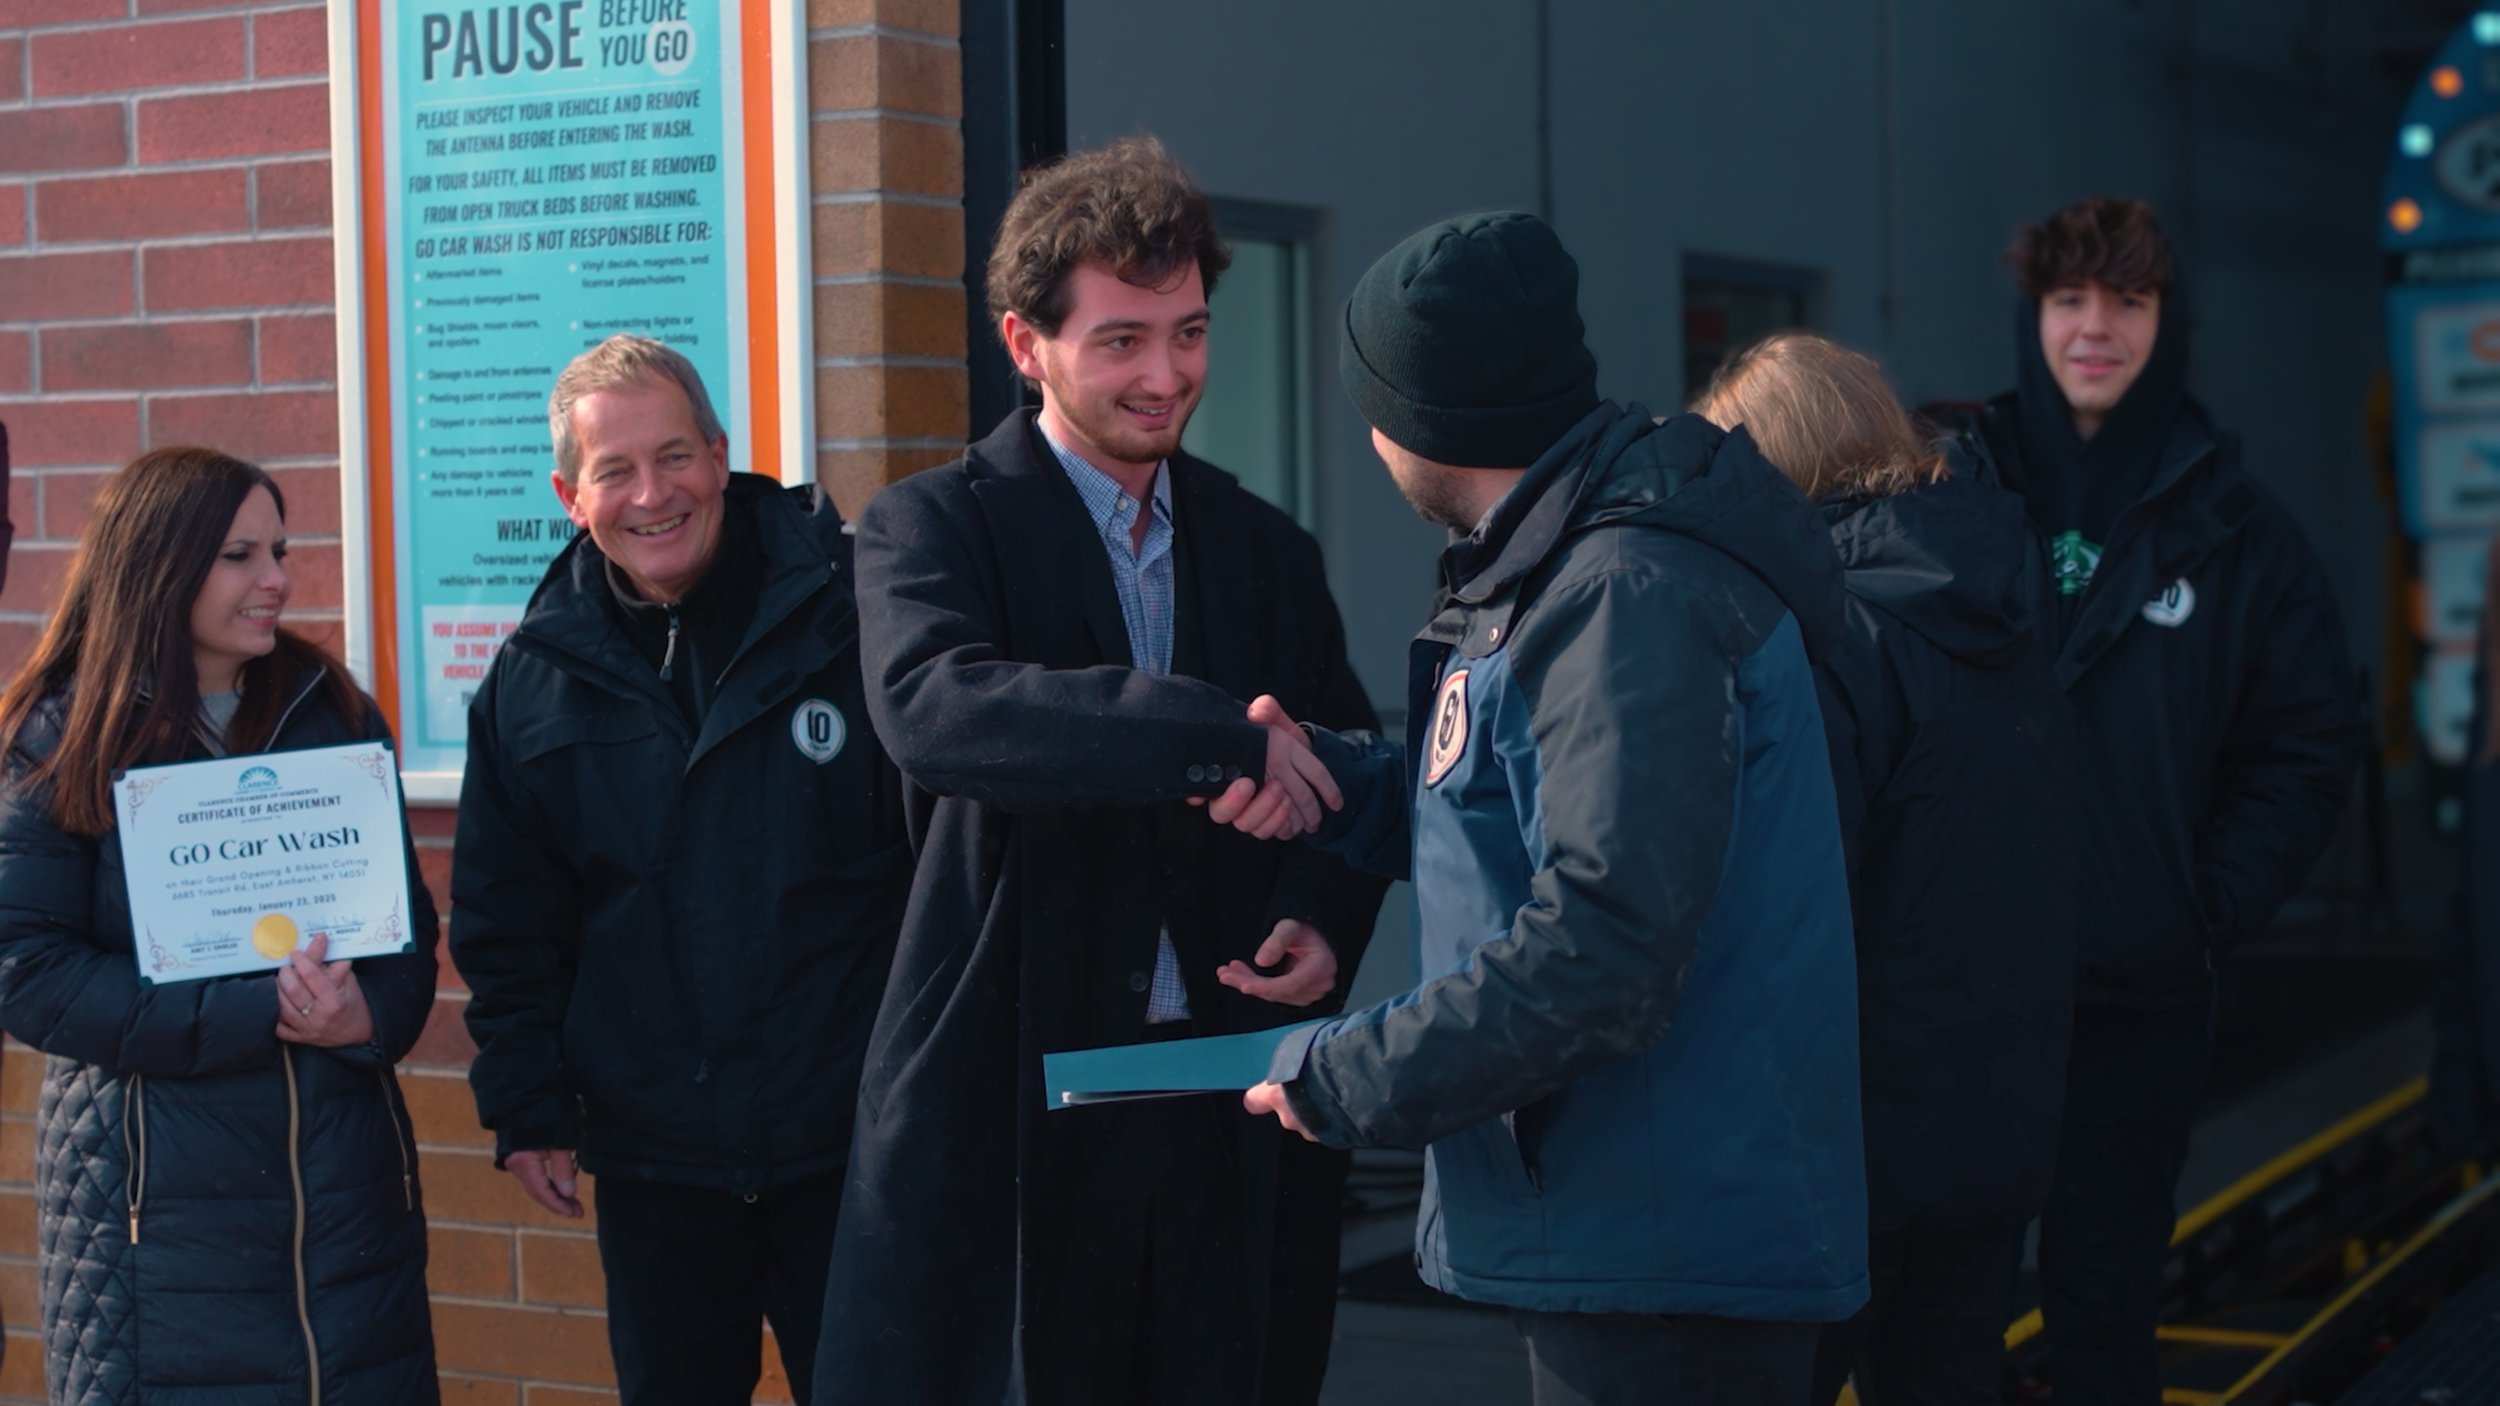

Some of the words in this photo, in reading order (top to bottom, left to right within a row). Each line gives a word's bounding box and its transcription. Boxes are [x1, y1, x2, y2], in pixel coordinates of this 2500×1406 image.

[599, 0, 688, 28] BEFORE
[422, 1, 584, 81] PAUSE
[600, 33, 647, 68] YOU
[655, 30, 688, 63] GO
[416, 109, 460, 130] PLEASE
[463, 105, 514, 126] INSPECT
[518, 101, 553, 122] YOUR
[557, 96, 610, 118] VEHICLE
[613, 94, 642, 115] AND
[646, 90, 701, 111] REMOVE
[426, 138, 447, 157] THE
[450, 135, 505, 155] ANTENNA
[508, 130, 556, 150] BEFORE
[558, 124, 620, 146] ENTERING
[624, 122, 648, 141] THE
[652, 119, 695, 139] WASH.
[409, 175, 432, 194] FOR
[435, 171, 468, 191] YOUR
[472, 168, 518, 189] SAFETY,
[522, 166, 544, 185] ALL
[549, 163, 586, 183] ITEMS
[590, 160, 626, 179] MUST
[630, 158, 647, 177] BE
[652, 154, 717, 176] REMOVED
[424, 205, 458, 224] FROM
[461, 202, 493, 222] OPEN
[498, 199, 539, 219] TRUCK
[543, 196, 576, 215] BEDS
[580, 192, 629, 213] BEFORE
[634, 188, 701, 210] WASHING.
[415, 238, 435, 259] GO
[439, 236, 468, 257] CAR
[473, 233, 513, 255] WASH
[518, 231, 532, 252] IS
[536, 229, 565, 251] NOT
[570, 222, 672, 248] RESPONSIBLE
[677, 220, 713, 242] FOR:
[497, 519, 542, 542] WHAT
[549, 518, 575, 541] WO
[473, 552, 528, 567] Oversized
[439, 575, 482, 587] vehicles
[486, 574, 509, 586] with
[432, 622, 454, 638] YOU
[456, 621, 497, 638] ASSUME
[455, 643, 468, 659] TO
[470, 643, 489, 658] THE
[443, 664, 484, 680] VEHICLE
[177, 806, 245, 825] CERTIFICATE
[250, 804, 263, 816] OF
[266, 795, 342, 814] ACHIEVEMENT
[169, 842, 211, 867] GO
[219, 836, 269, 861] Car
[277, 826, 360, 853] Wash
[166, 881, 178, 890] on
[181, 877, 202, 888] their
[206, 873, 237, 885] Grand
[240, 867, 282, 882] Opening
[285, 865, 292, 875] &
[295, 861, 329, 873] Ribbon
[332, 857, 369, 869] Cutting
[199, 885, 231, 897] Transit
[252, 879, 274, 891] East
[277, 875, 320, 888] Amherst,
[322, 872, 336, 882] NY
[211, 905, 256, 918] Thursday,
[259, 898, 294, 912] January
[314, 893, 337, 905] 2025
